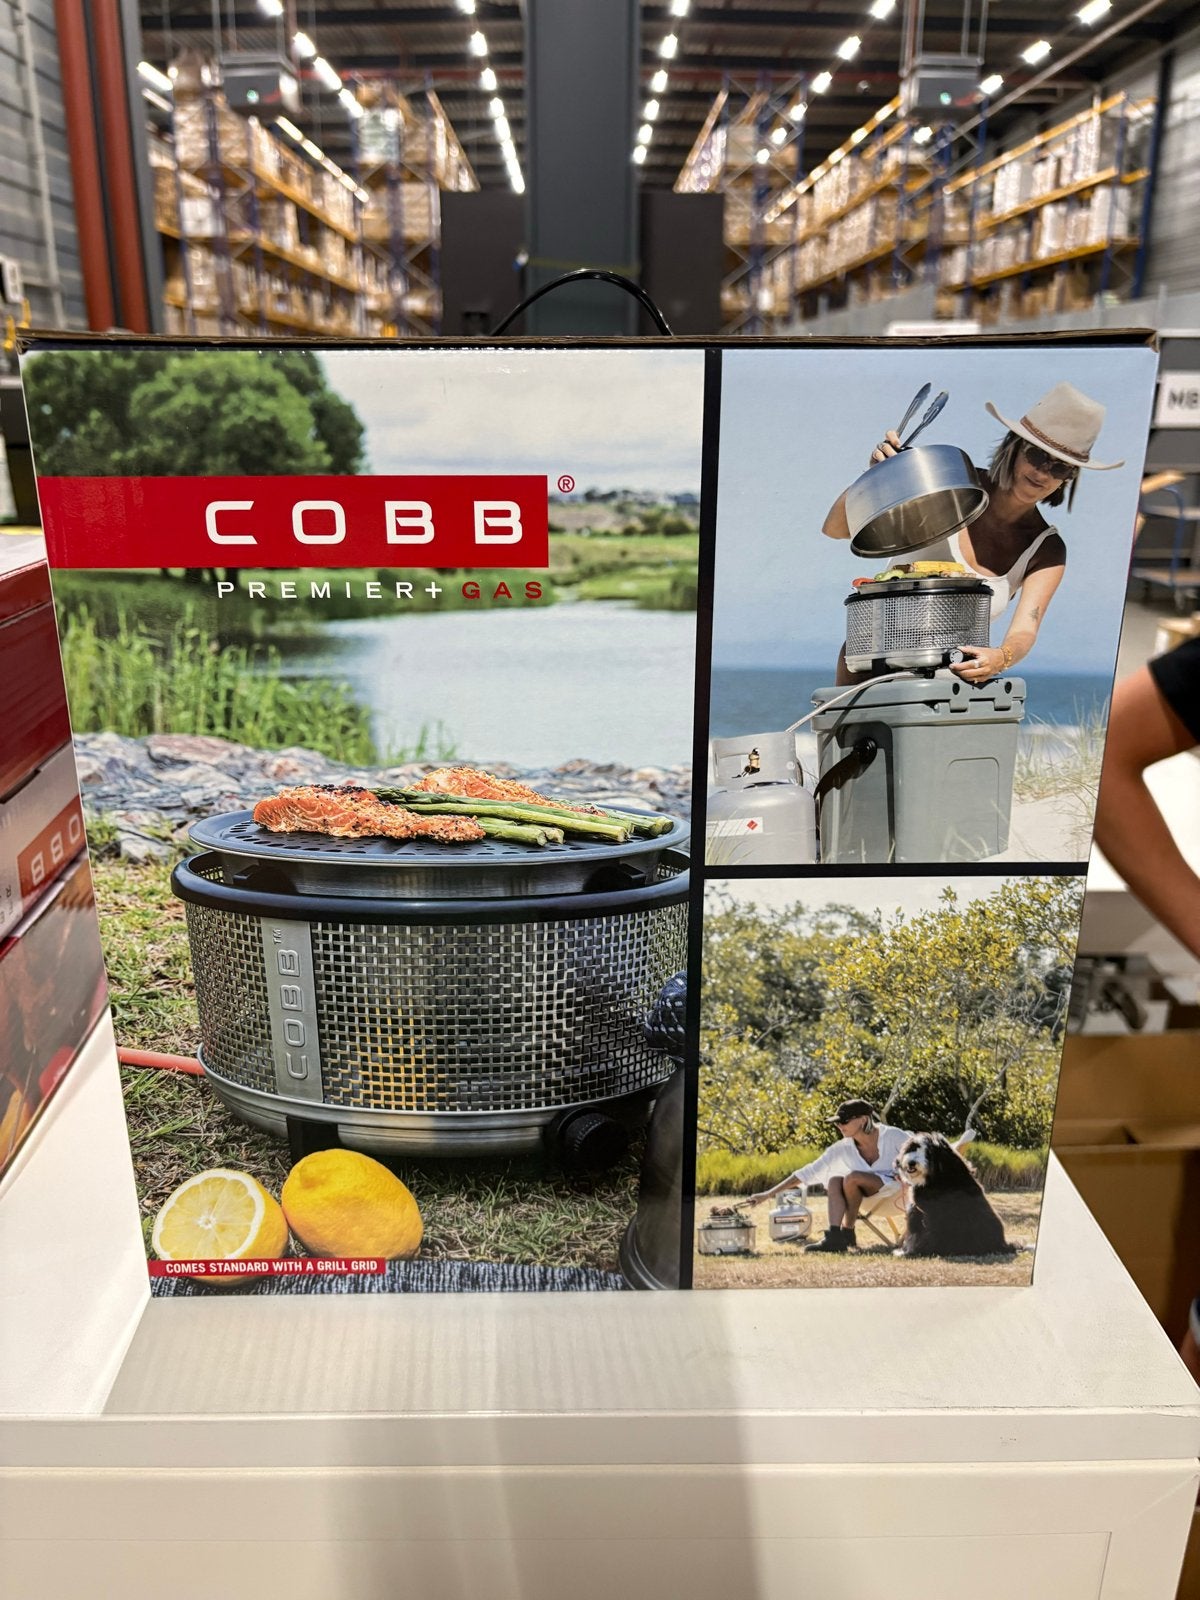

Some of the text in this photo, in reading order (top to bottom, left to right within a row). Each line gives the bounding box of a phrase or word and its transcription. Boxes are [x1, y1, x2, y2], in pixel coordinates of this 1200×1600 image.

[206, 500, 523, 545] COBB
[217, 581, 543, 600] PREMIER+ GAS
[277, 948, 309, 1080] COBB
[165, 1260, 378, 1274] COMES STANDARD WITH A GRILL GRID
